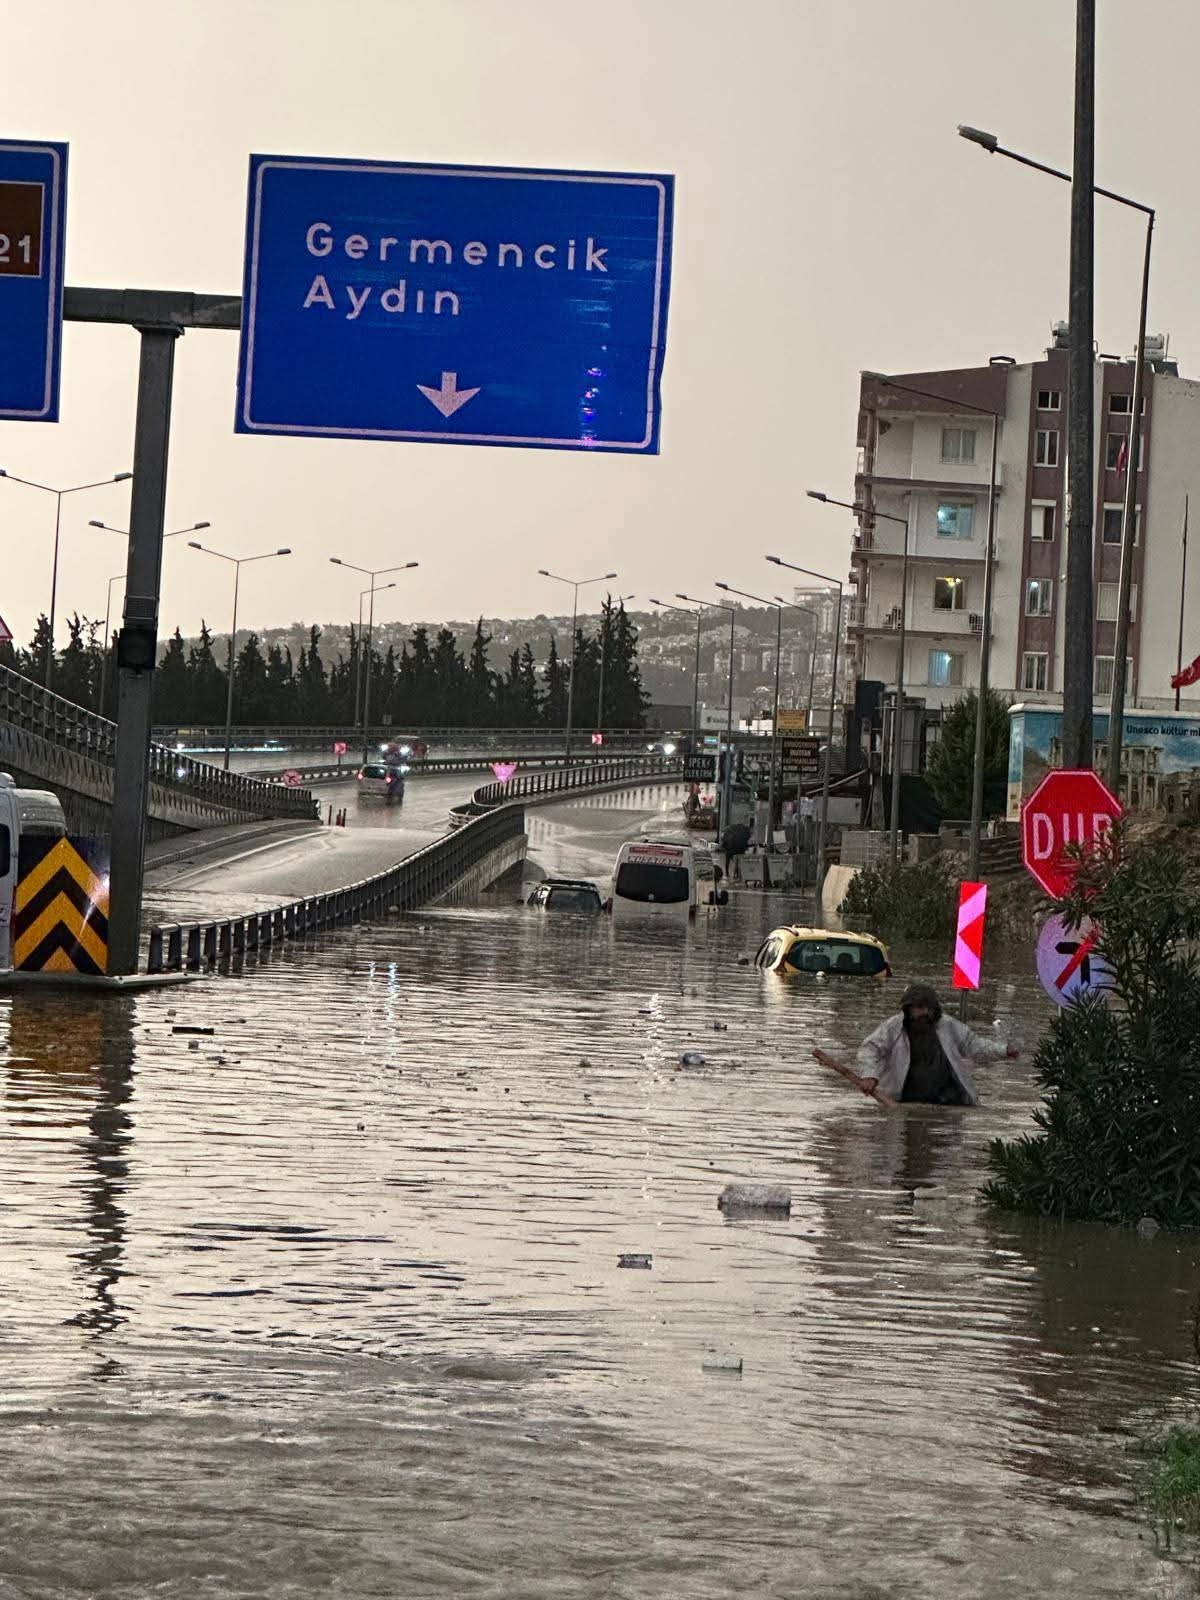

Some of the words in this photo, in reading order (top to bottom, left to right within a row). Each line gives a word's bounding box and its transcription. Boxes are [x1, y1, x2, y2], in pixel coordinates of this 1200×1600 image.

[306, 222, 608, 272] Germencik
[303, 275, 460, 320] Aydın
[1126, 725, 1159, 735] Unesco
